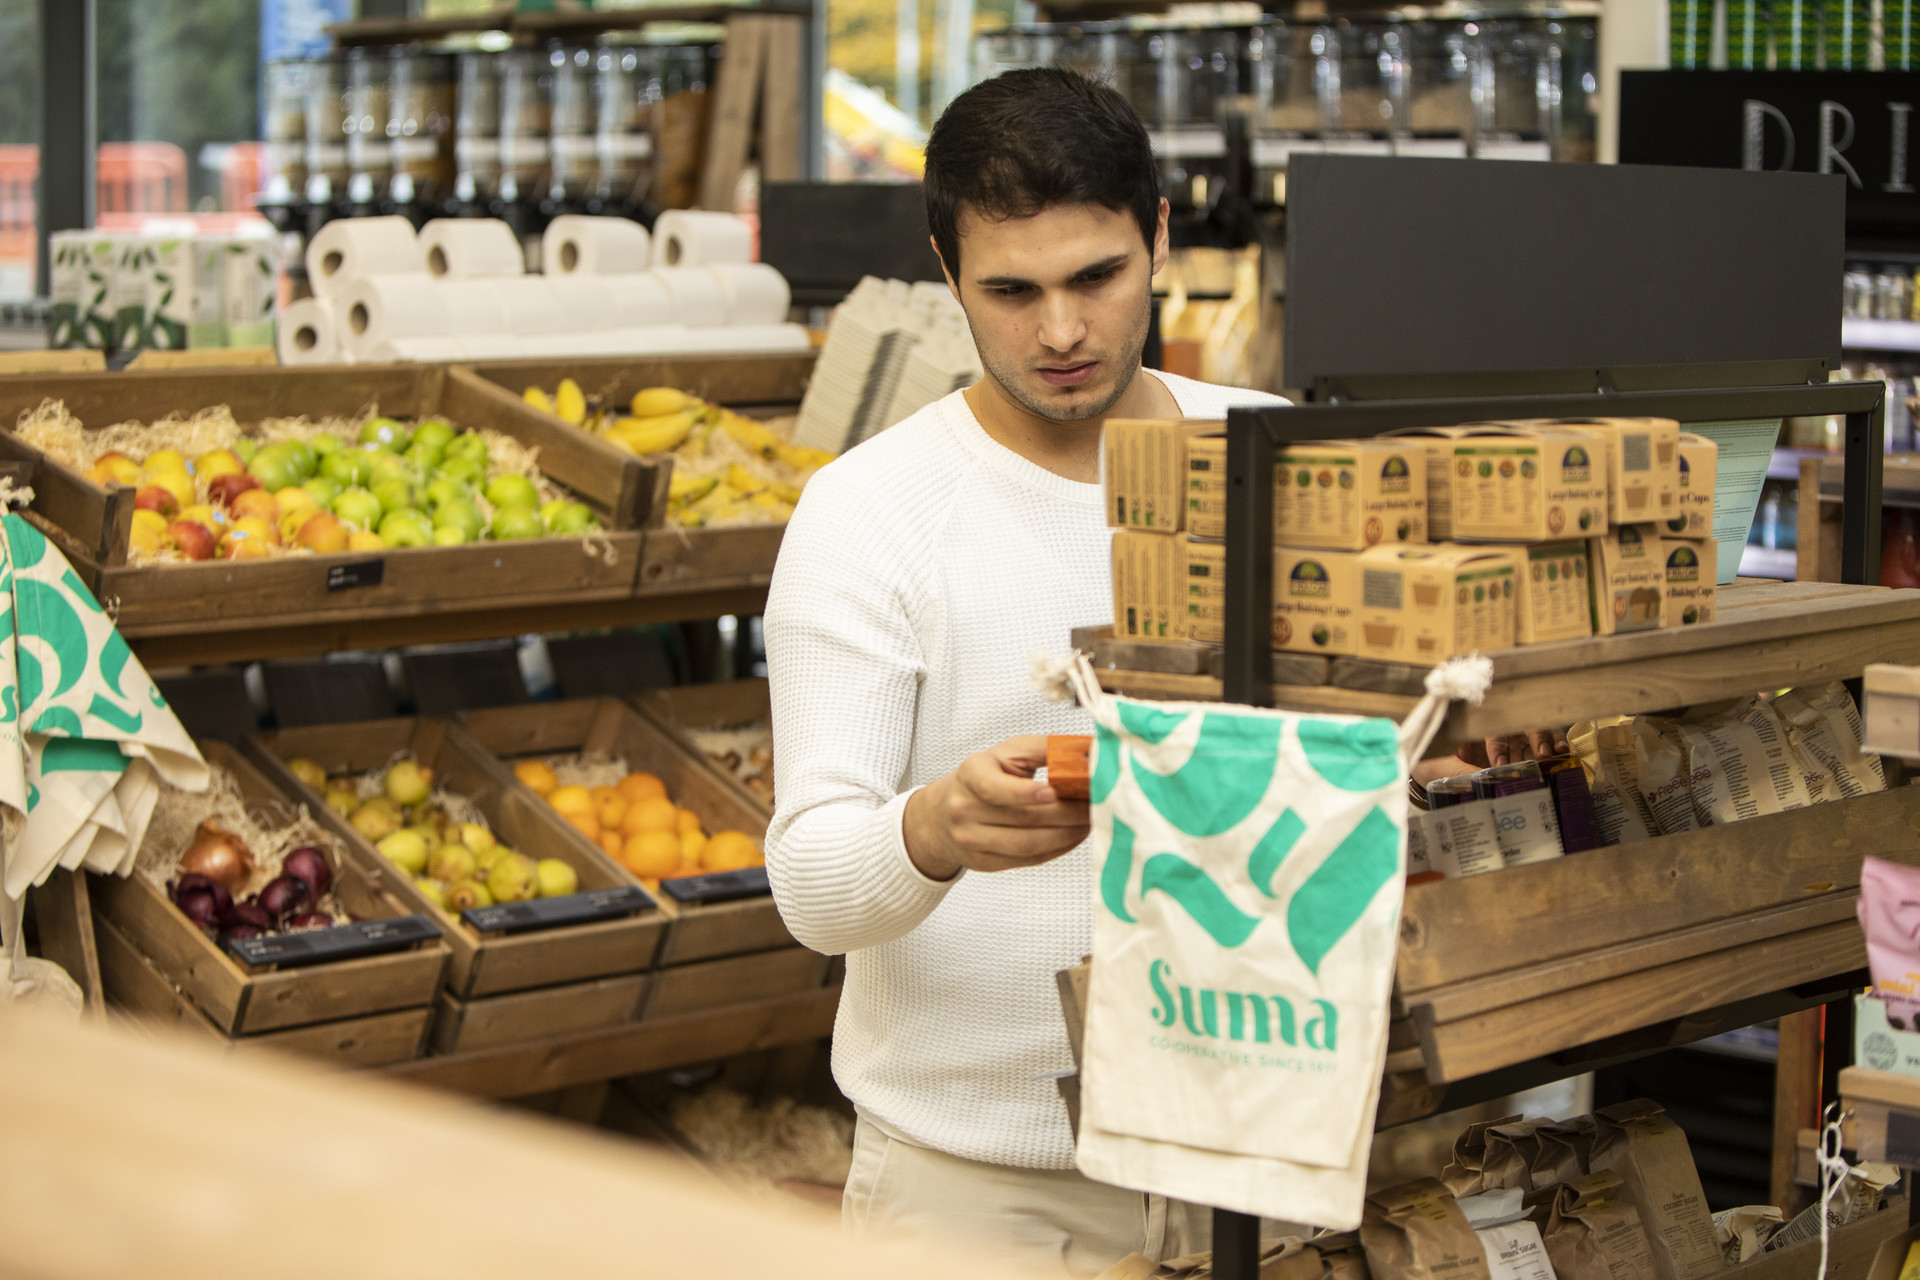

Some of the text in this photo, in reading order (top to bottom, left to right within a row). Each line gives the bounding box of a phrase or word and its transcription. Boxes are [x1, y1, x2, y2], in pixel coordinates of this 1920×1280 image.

[1672, 586, 1714, 602] Baking Cups
[1297, 602, 1327, 615] Baking
[1657, 778, 1688, 799] freee
[1149, 957, 1339, 1053] Suma
[1258, 1054, 1304, 1073] SINCE
[1519, 1242, 1537, 1254] SUGAR
